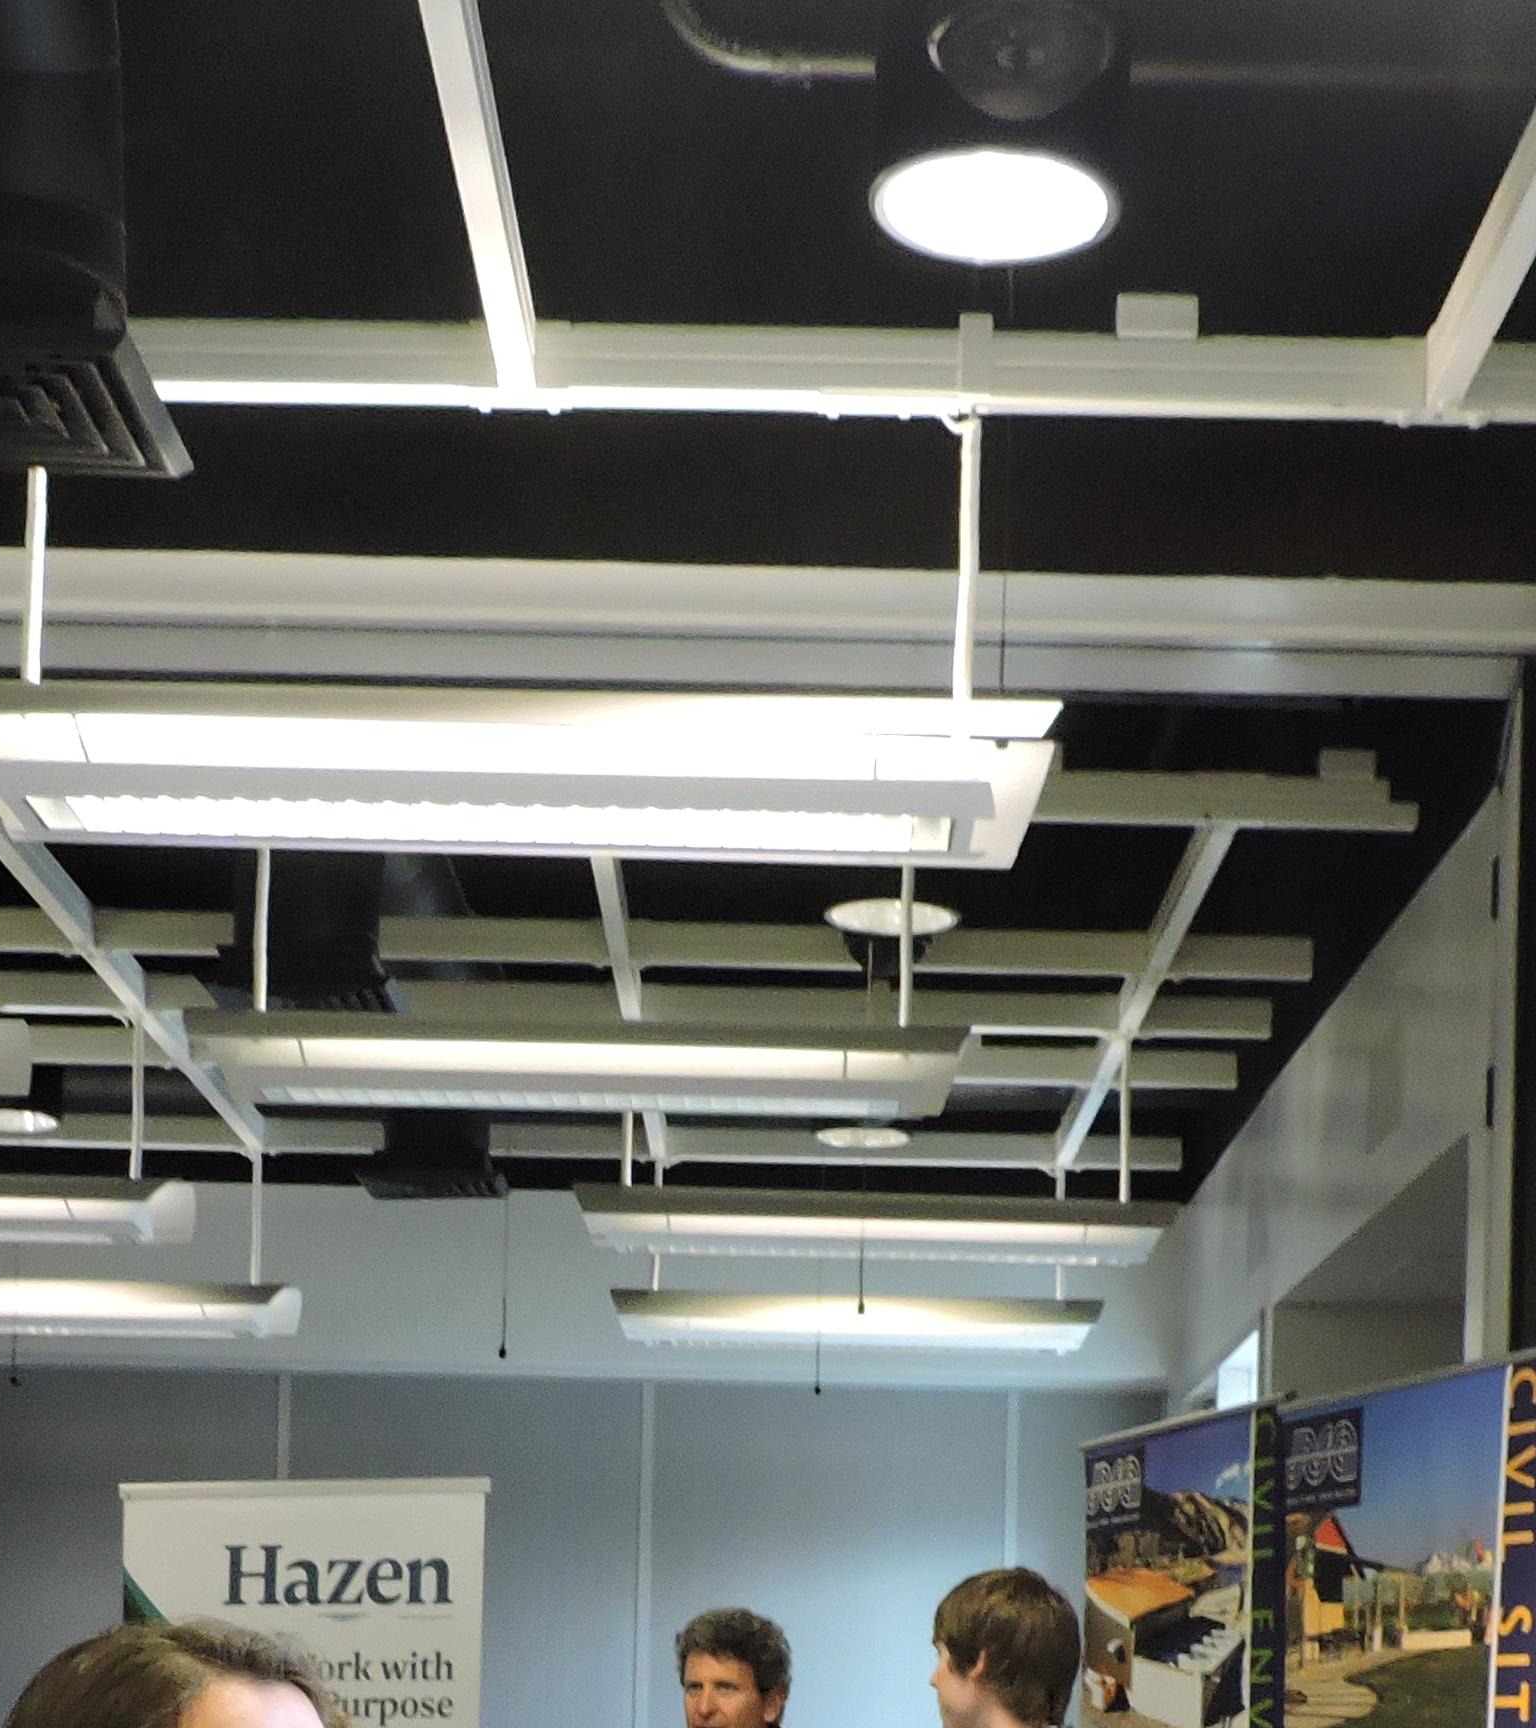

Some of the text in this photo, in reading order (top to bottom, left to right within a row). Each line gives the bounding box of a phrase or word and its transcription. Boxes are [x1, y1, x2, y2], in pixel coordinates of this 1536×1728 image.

[223, 1543, 454, 1607] Hazen
[315, 1650, 454, 1682] ork with
